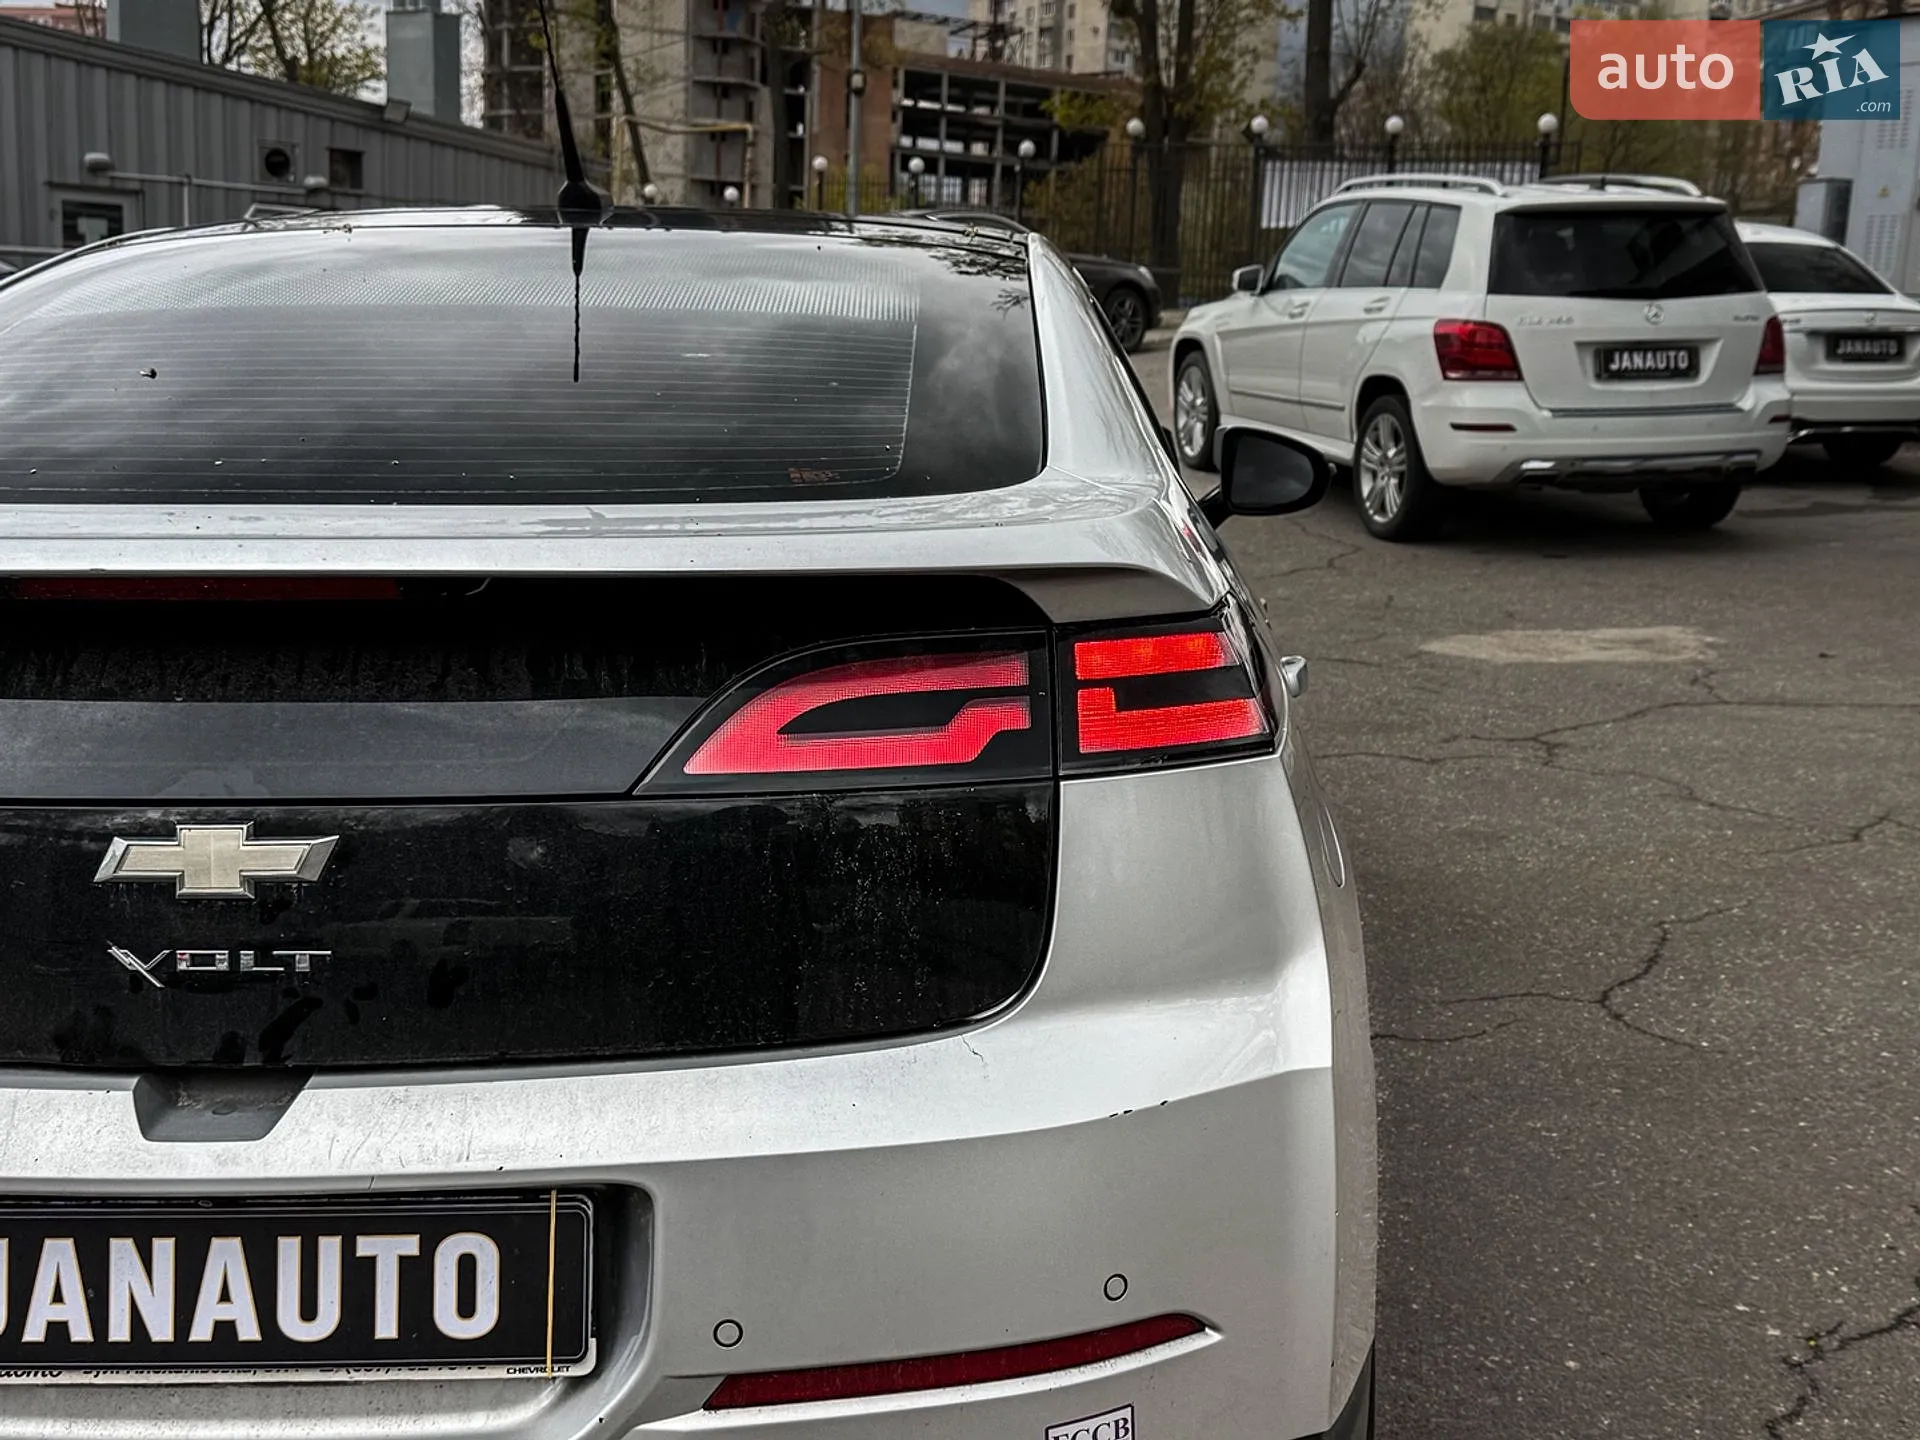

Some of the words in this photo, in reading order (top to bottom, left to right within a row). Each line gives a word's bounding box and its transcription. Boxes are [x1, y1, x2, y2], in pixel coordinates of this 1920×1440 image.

[1608, 349, 1690, 371] JANAUTO
[106, 940, 332, 988] VOLT
[0, 1231, 501, 1343] ANAUTO
